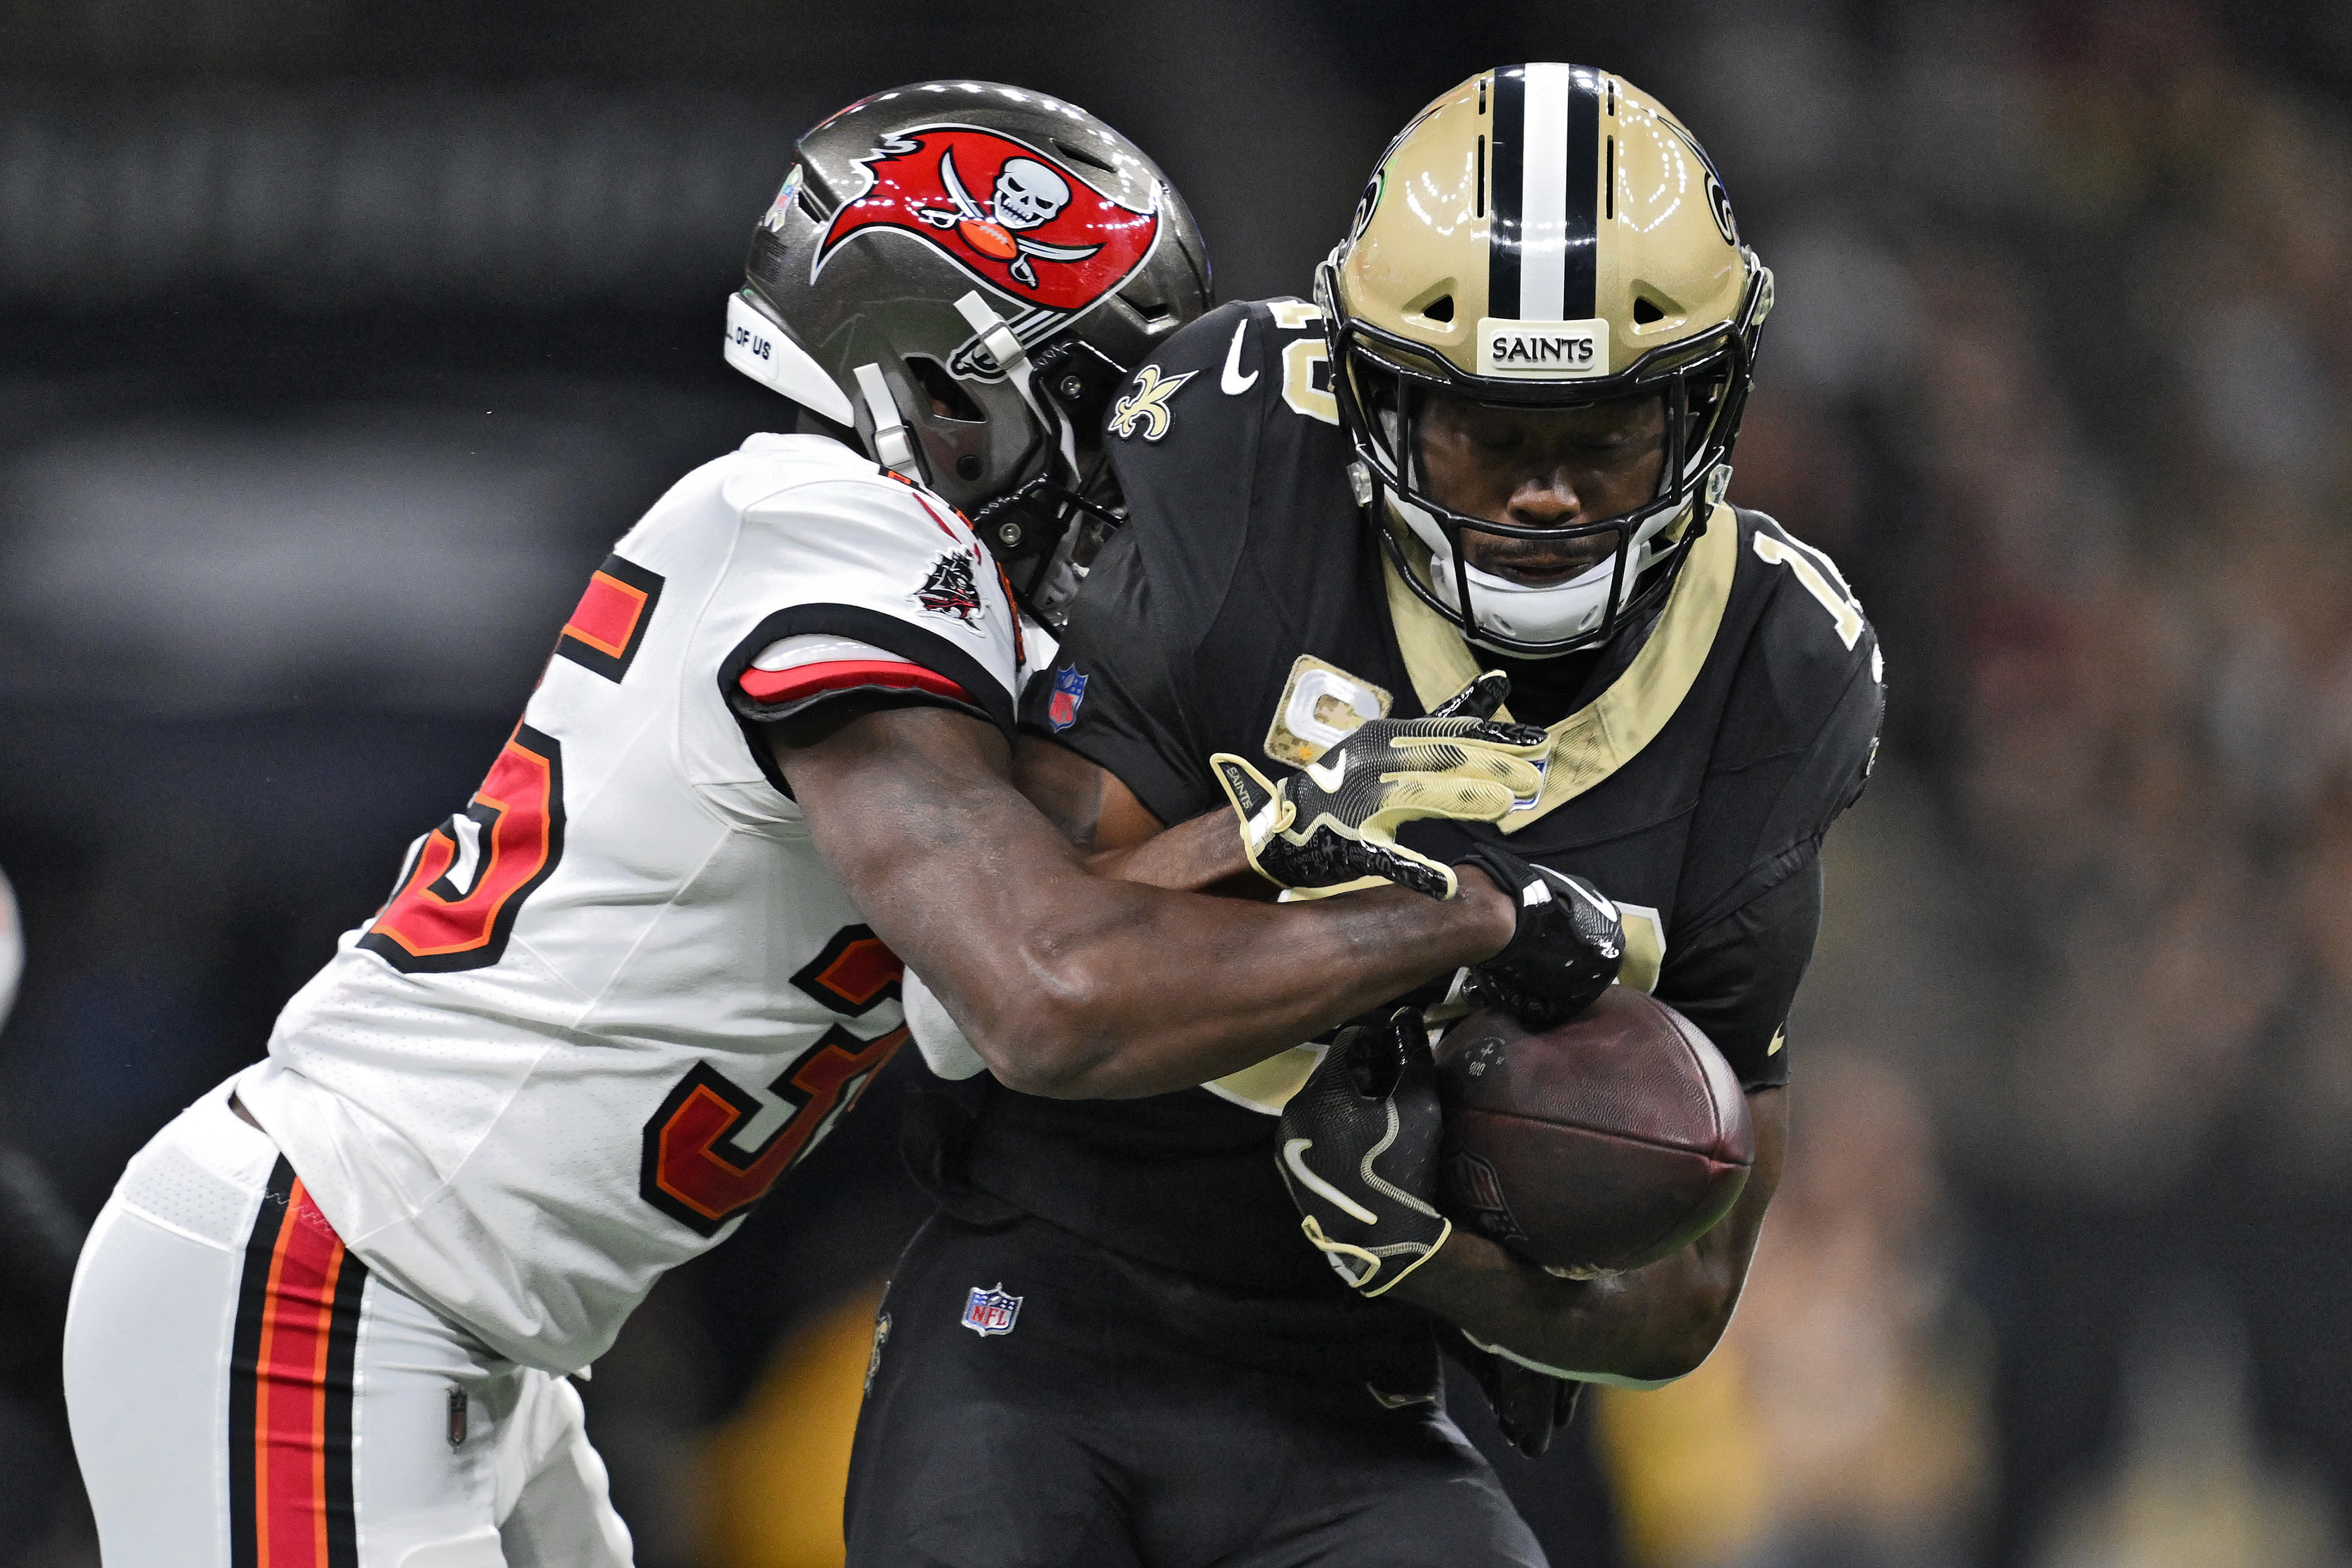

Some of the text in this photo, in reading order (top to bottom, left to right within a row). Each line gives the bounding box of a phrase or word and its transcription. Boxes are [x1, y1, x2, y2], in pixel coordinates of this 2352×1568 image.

[736, 326, 771, 360] OF US
[1492, 337, 1593, 361] SAINTS
[1752, 508, 1865, 651] 1
[1285, 669, 1381, 750] C
[1226, 766, 1253, 809] SAINTS
[969, 1305, 1006, 1326] NFL
